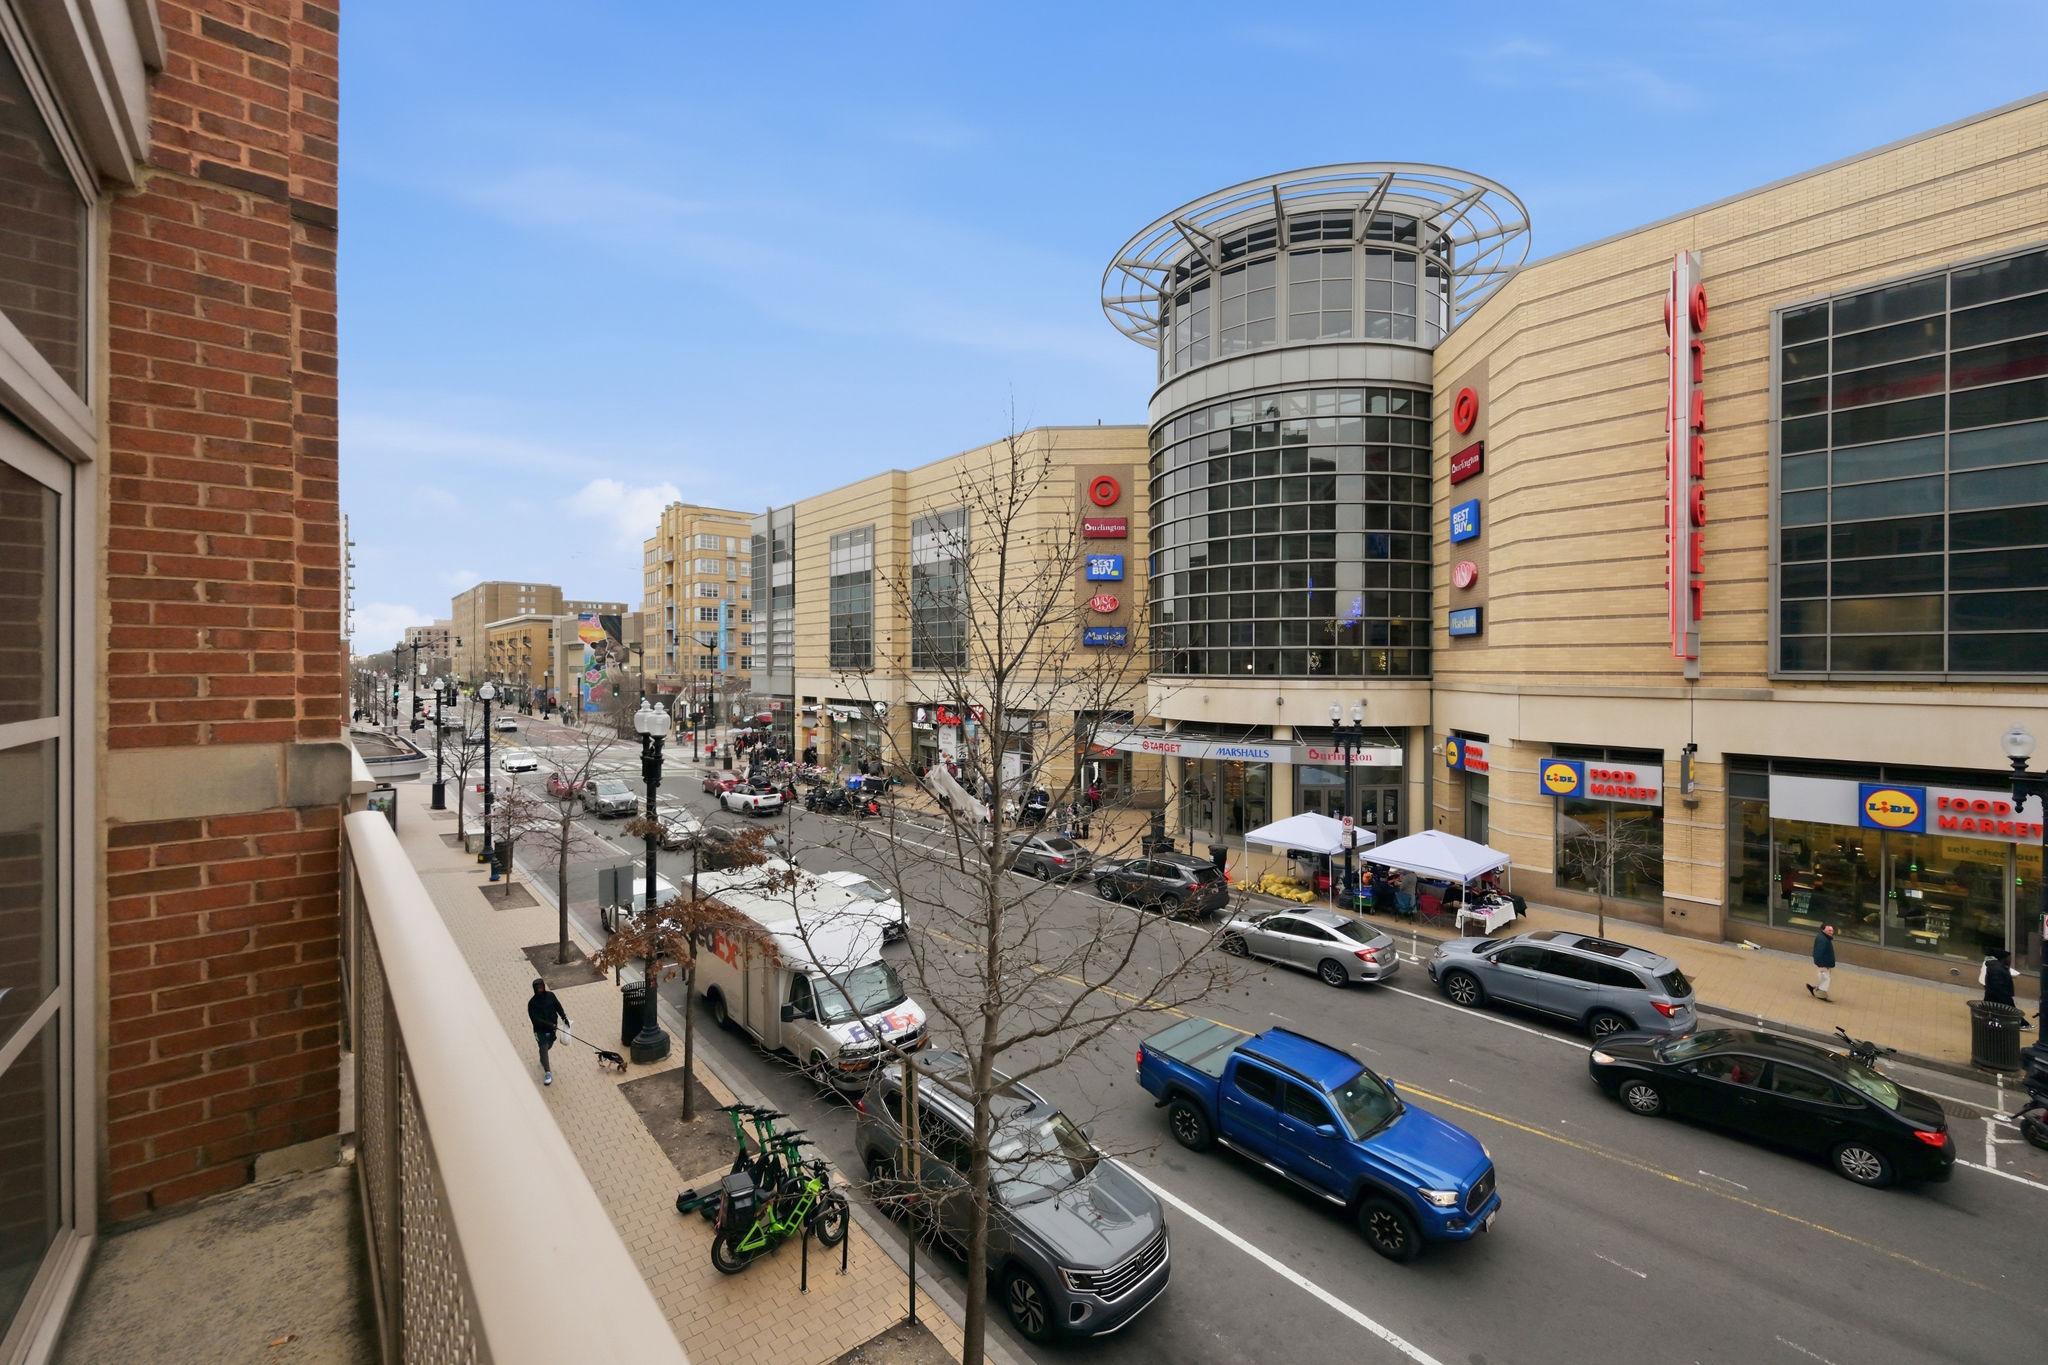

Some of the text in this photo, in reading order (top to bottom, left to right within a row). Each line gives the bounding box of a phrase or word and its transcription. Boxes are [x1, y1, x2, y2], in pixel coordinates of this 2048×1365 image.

[1690, 339, 1706, 621] TARGET
[1453, 508, 1469, 524] BEST
[1454, 520, 1468, 534] BUY
[1092, 567, 1112, 575] BUY
[1150, 742, 1182, 753] TARGET
[1215, 747, 1270, 759] MARSHALLS
[1589, 768, 1637, 784] FOOD
[1590, 782, 1659, 800] MARKET
[1937, 796, 2012, 817] FOOD
[1938, 814, 2044, 839] MARKET
[847, 1010, 920, 1043] FdEx
